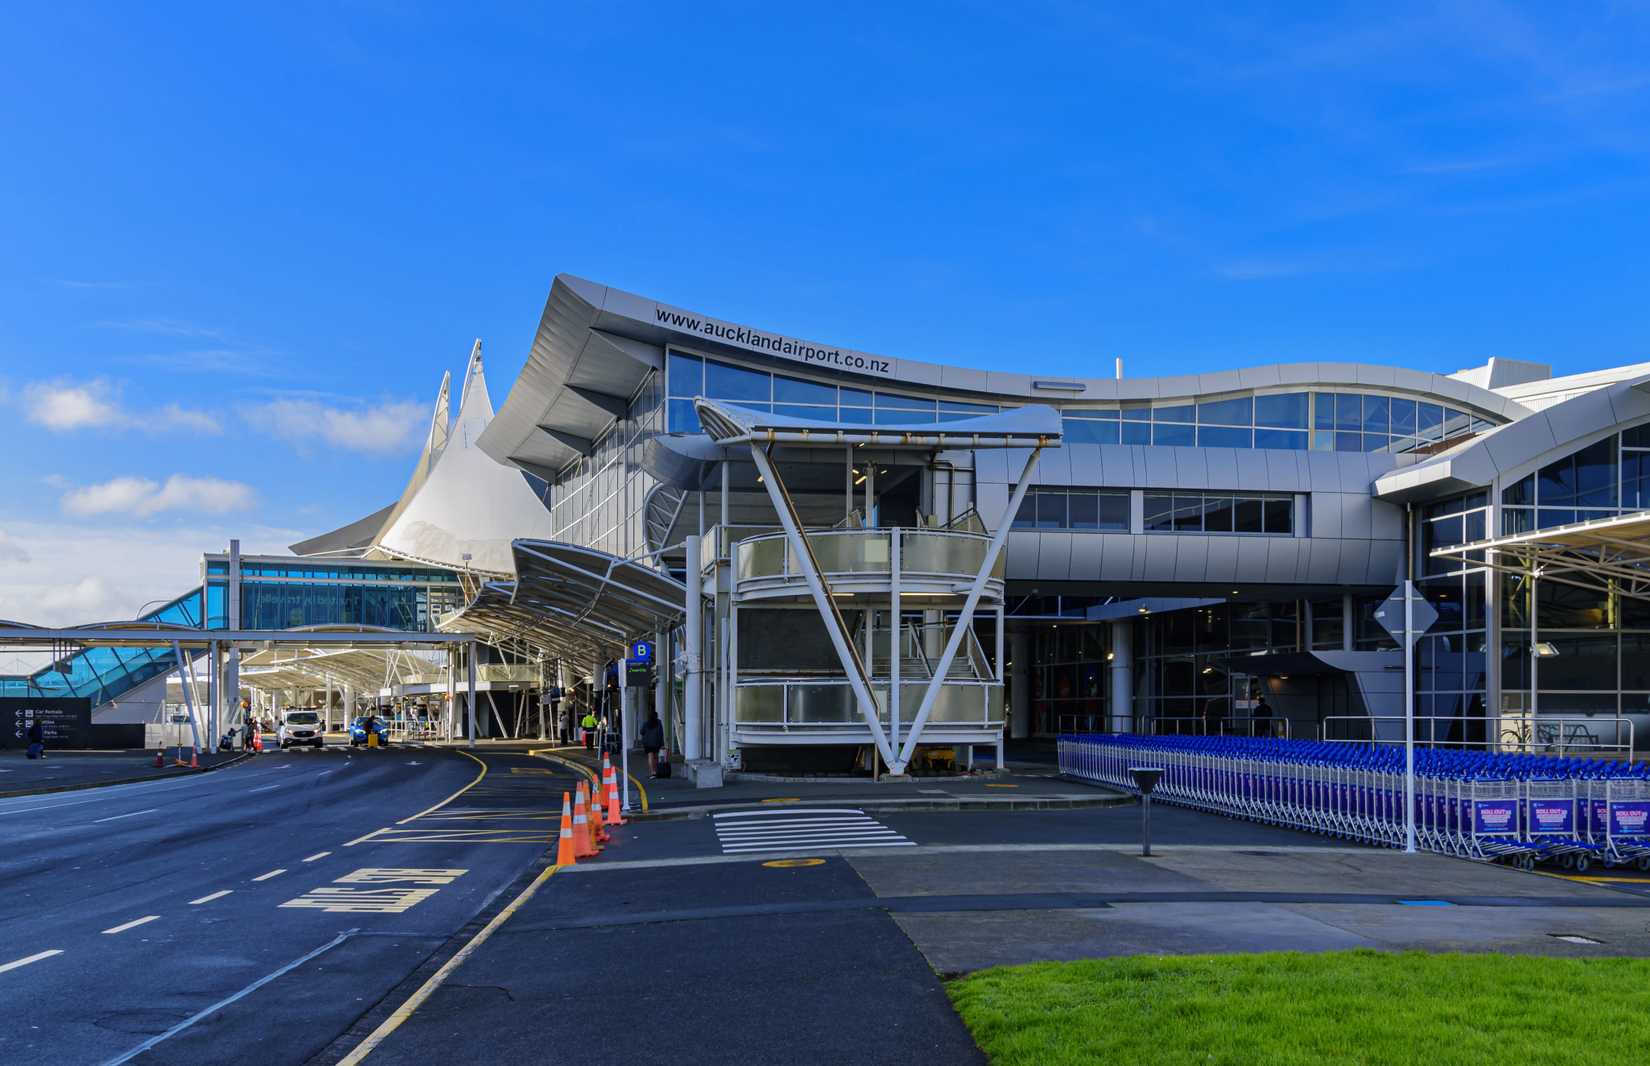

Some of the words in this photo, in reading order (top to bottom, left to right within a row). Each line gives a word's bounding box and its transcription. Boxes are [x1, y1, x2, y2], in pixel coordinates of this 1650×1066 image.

[656, 308, 889, 373] www.aucklandairport.co.nz
[637, 644, 647, 656] B
[331, 868, 470, 884] BUS
[277, 887, 441, 912] STOP
